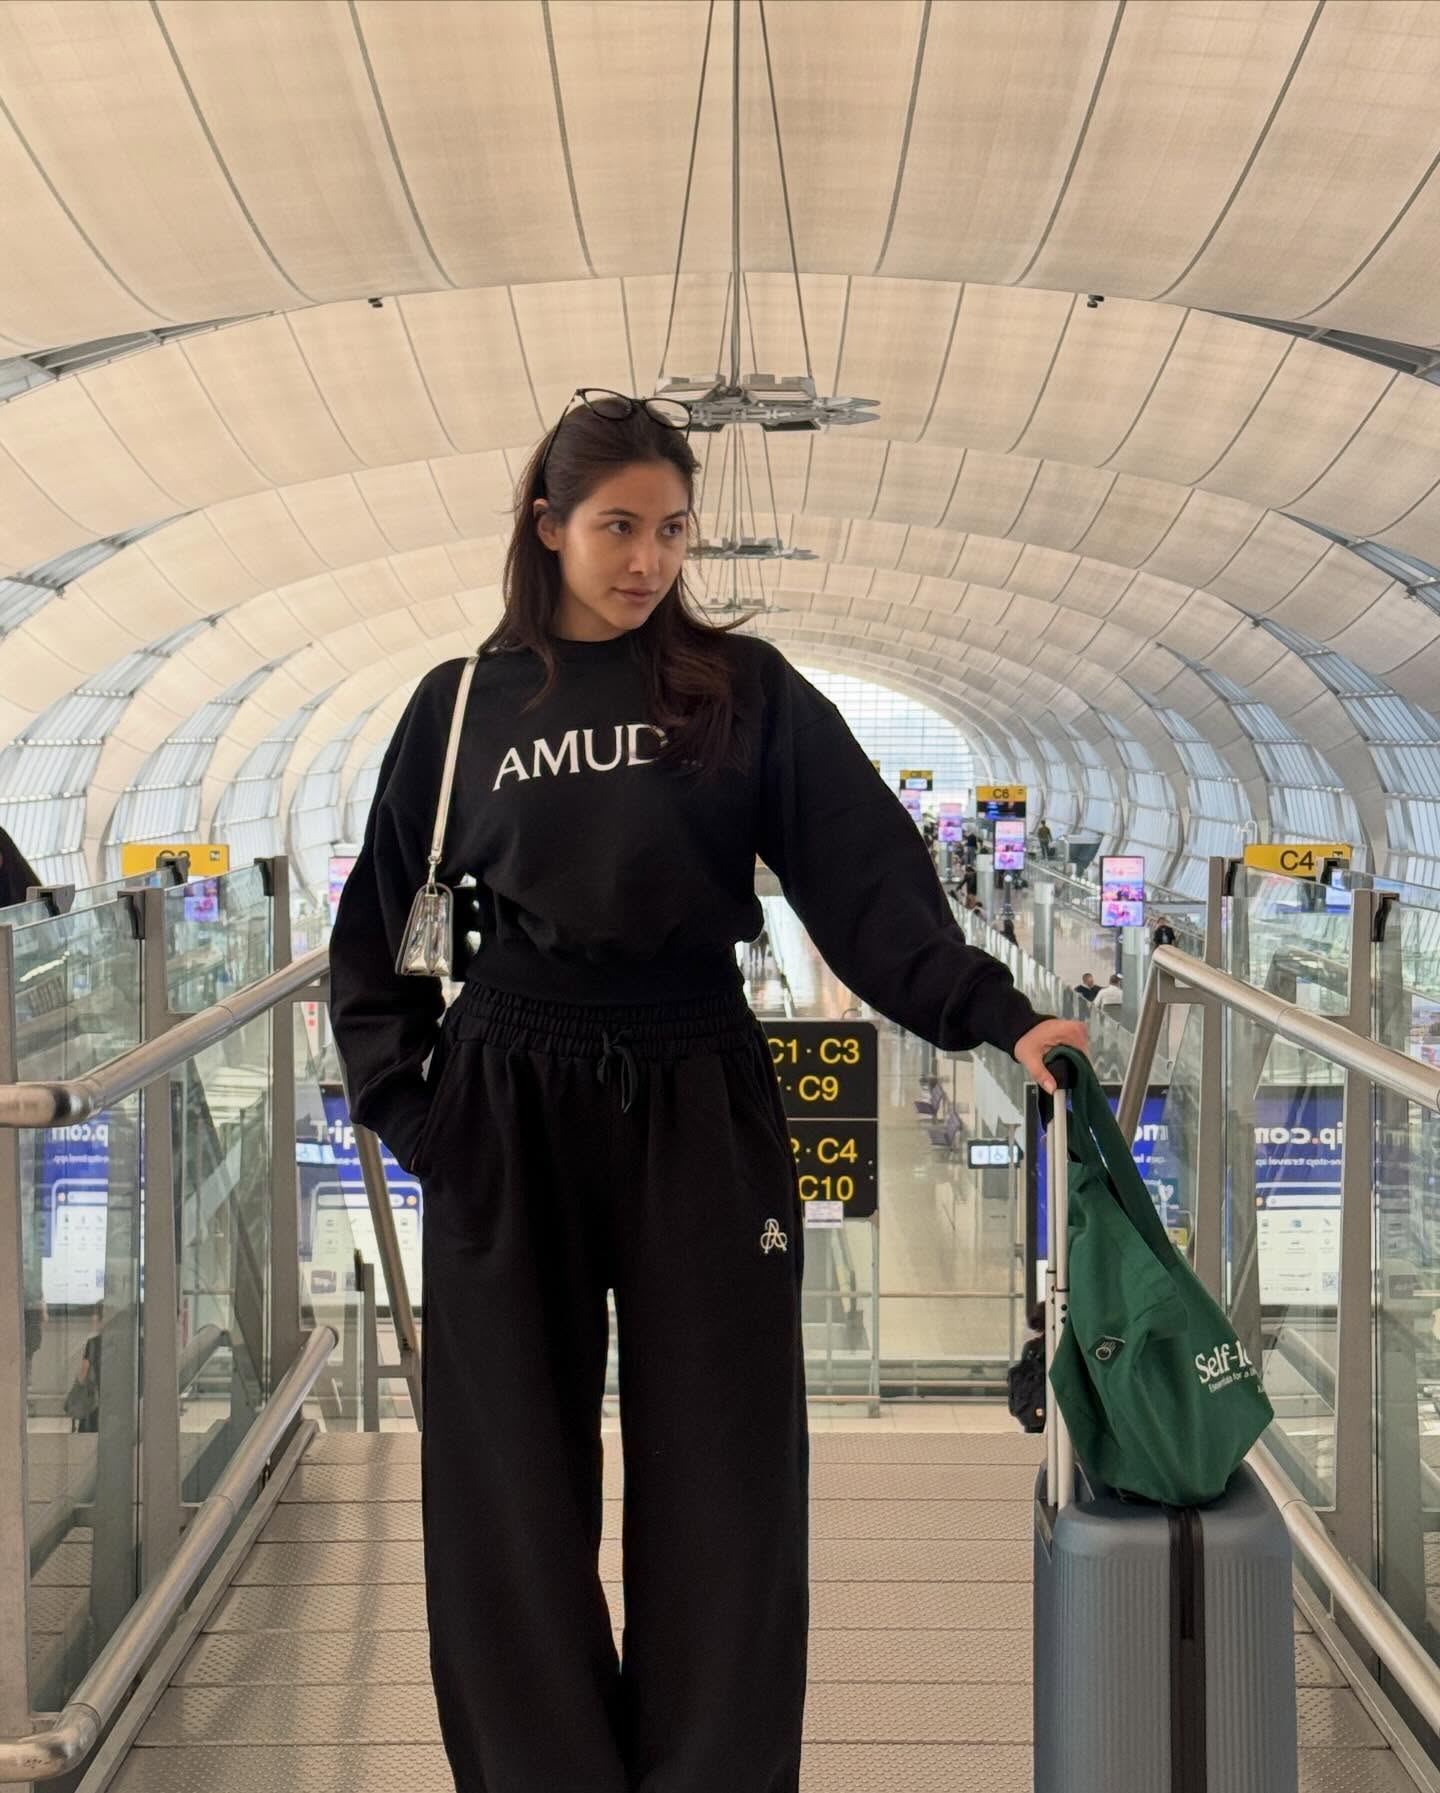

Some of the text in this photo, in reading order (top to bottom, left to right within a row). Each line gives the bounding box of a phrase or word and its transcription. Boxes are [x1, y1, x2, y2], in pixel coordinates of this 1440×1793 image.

[492, 723, 690, 792] AMUD
[1280, 850, 1315, 871] C4
[767, 1038, 860, 1064] C1 C3
[798, 1075, 839, 1101] C9
[817, 1137, 858, 1163] C4
[798, 1175, 854, 1201] C10
